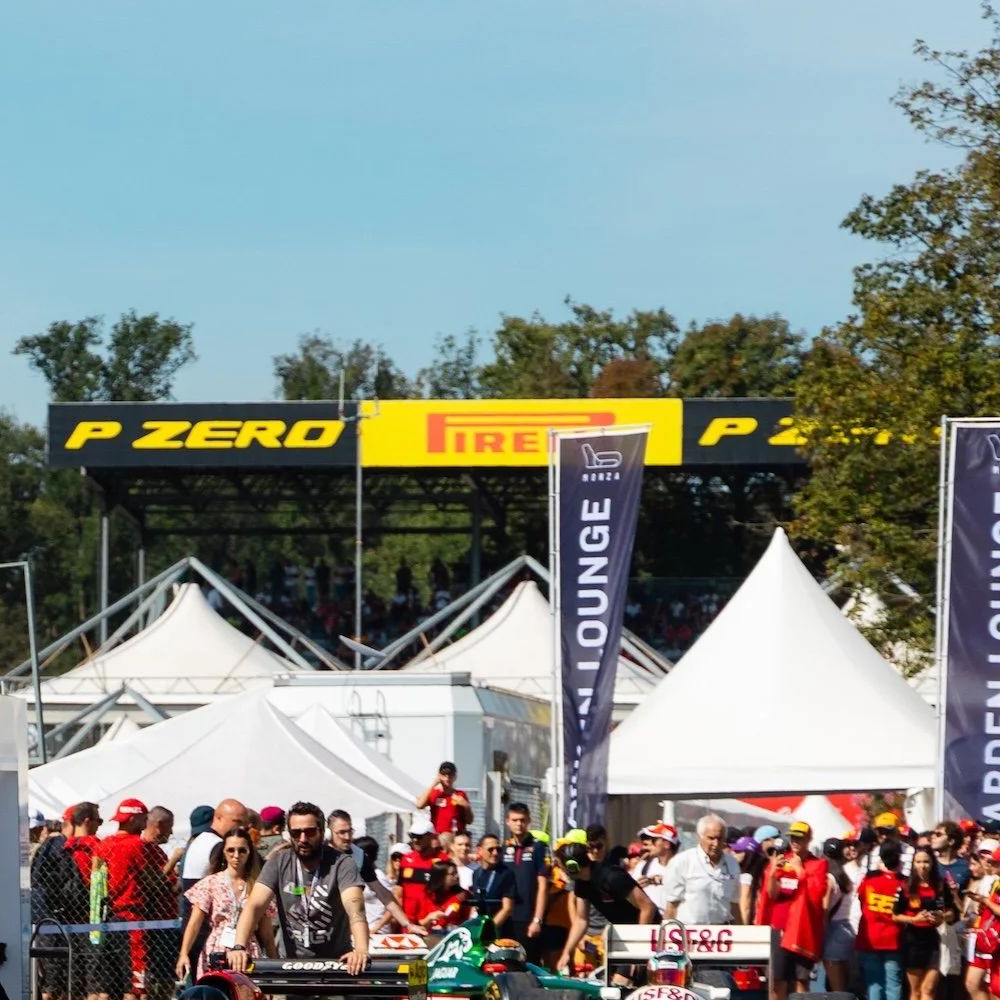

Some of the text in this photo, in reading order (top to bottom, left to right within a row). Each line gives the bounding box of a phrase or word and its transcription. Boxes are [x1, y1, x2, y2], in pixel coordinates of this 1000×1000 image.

[65, 420, 345, 449] P ZERO
[427, 412, 616, 453] PIRE
[698, 417, 758, 446] P
[577, 498, 612, 671] LOUNGE
[651, 929, 733, 953] USF&G
[282, 960, 349, 971] GOODY
